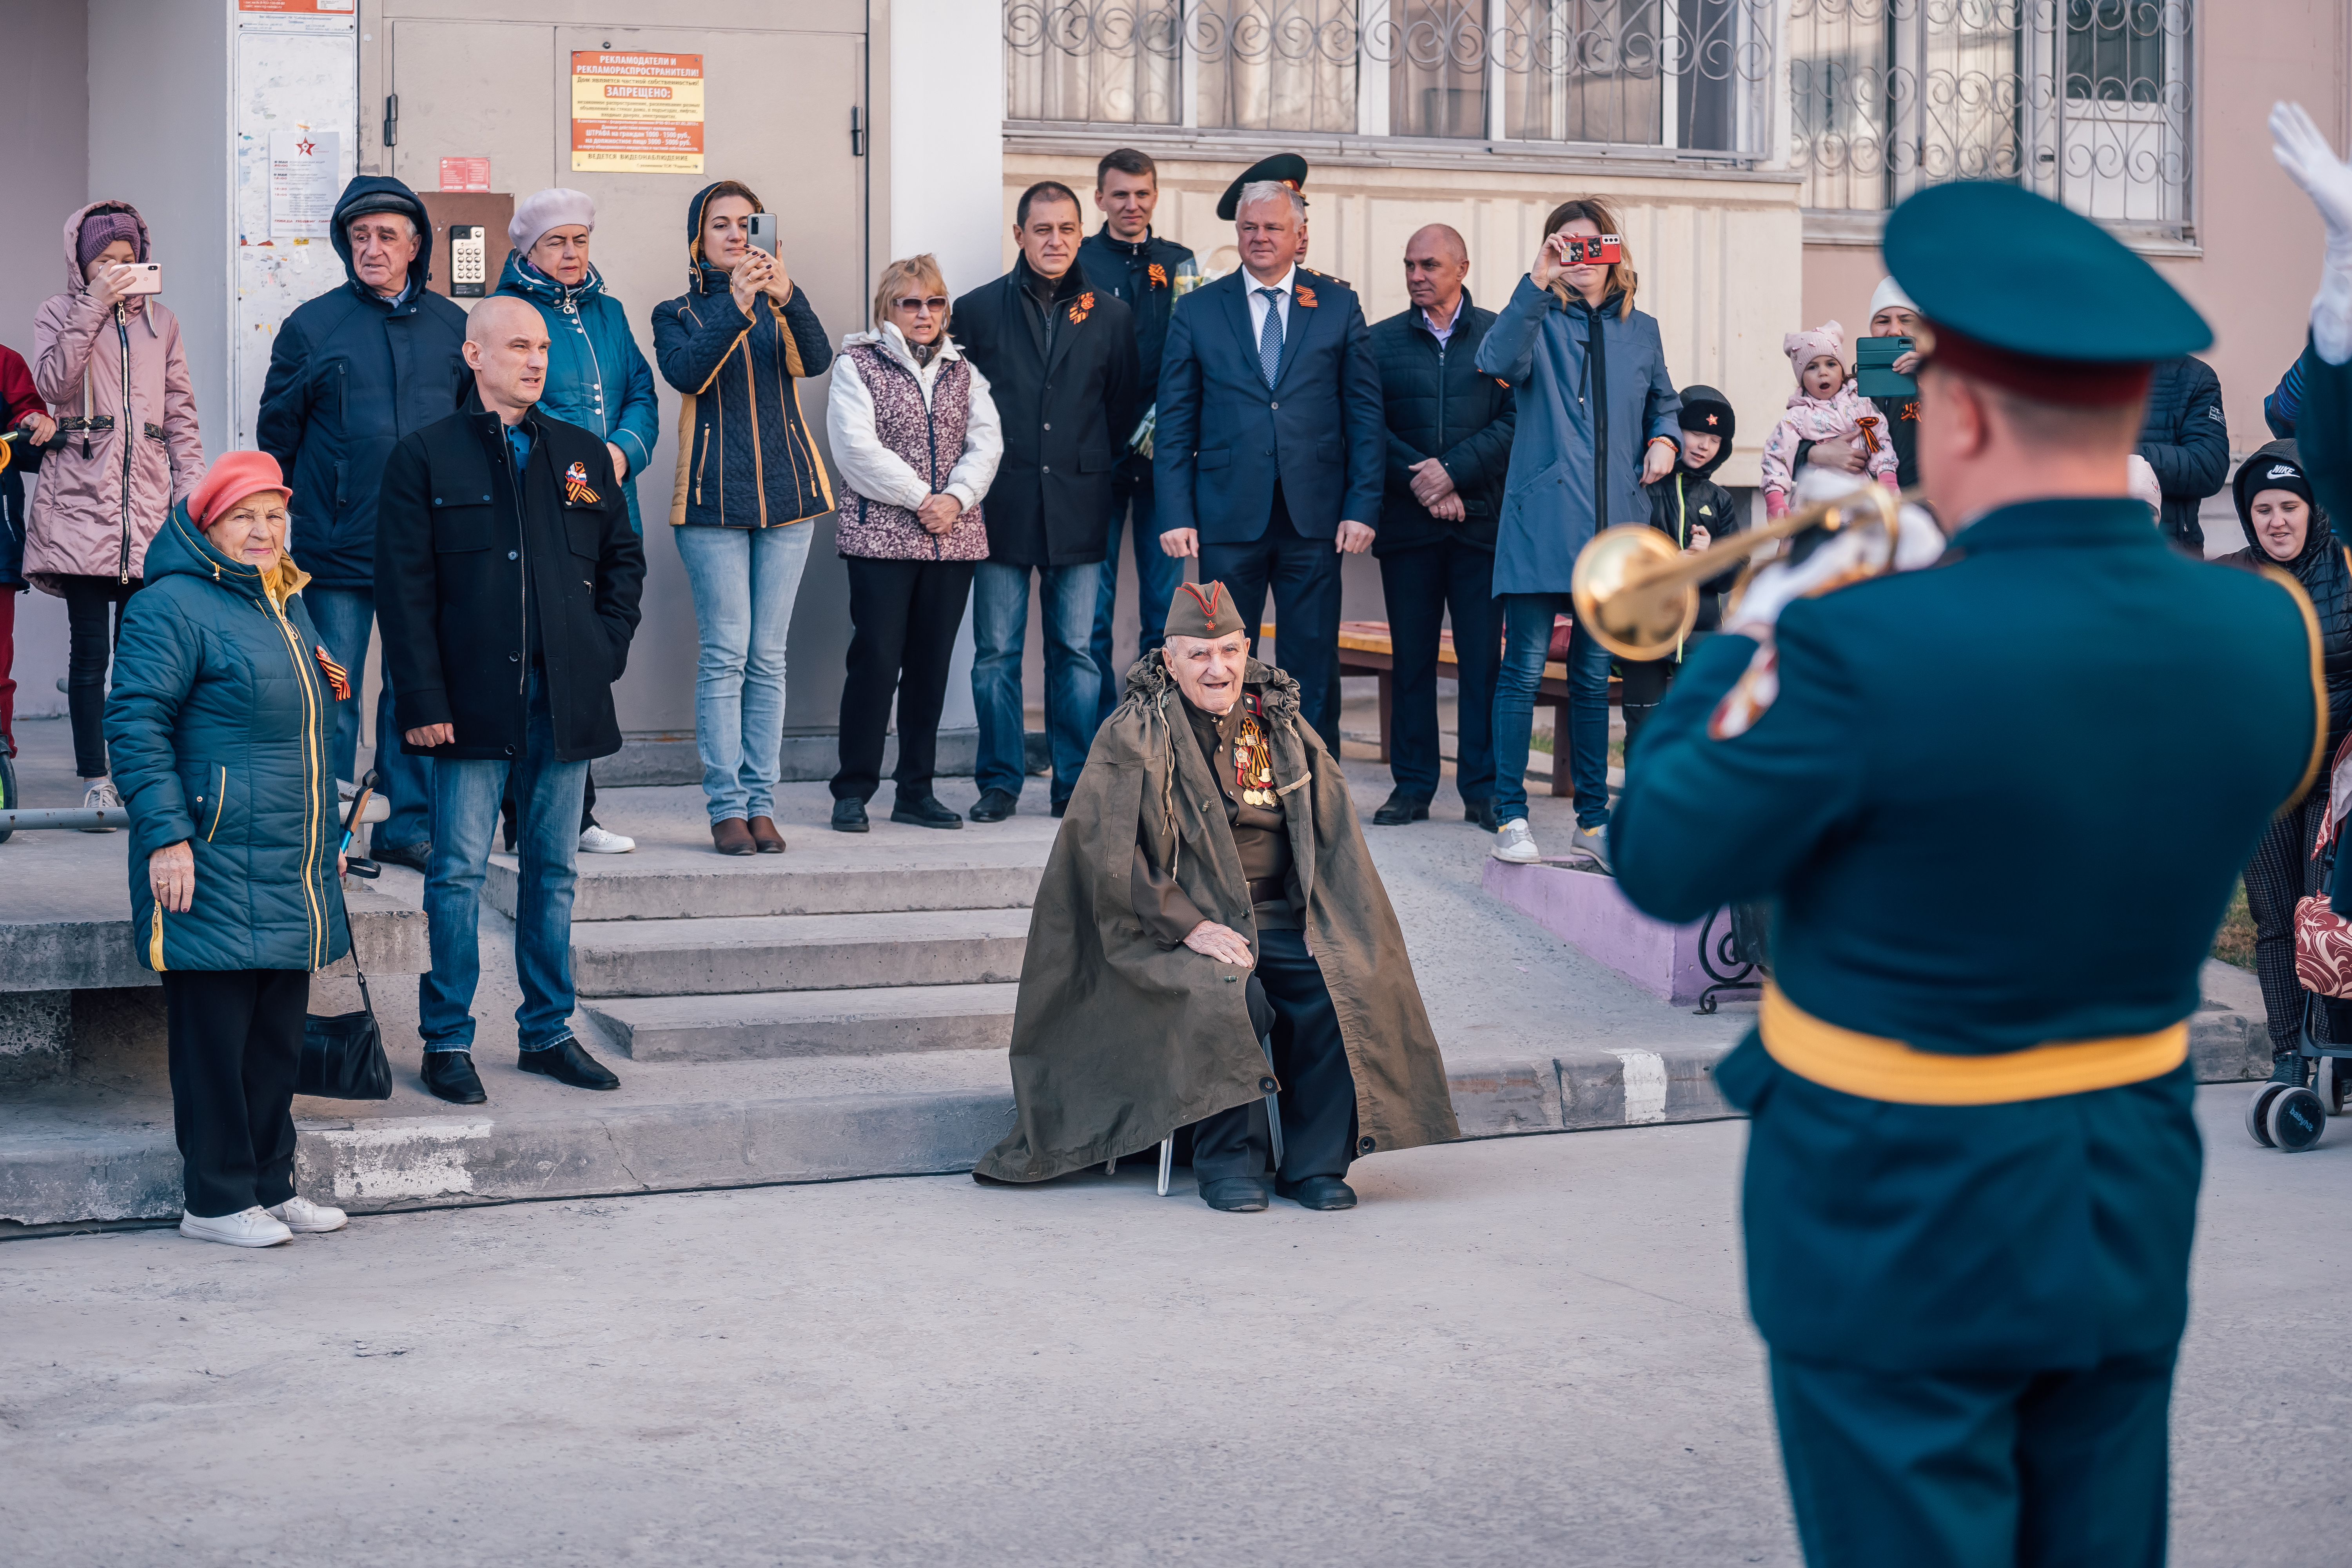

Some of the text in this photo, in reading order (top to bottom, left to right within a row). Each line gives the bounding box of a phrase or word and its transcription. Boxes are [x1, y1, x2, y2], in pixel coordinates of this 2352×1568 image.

[600, 55, 669, 66] РЕКЛАМОДАТЕЛИ
[577, 65, 699, 77] РЕКЛАМОРАСПРОСТРАНИТЕЛИ!
[606, 86, 671, 99] ЗАПРЕЩЕНО:
[2272, 465, 2295, 474] NIKE
[2289, 1107, 2313, 1132] babyhit
